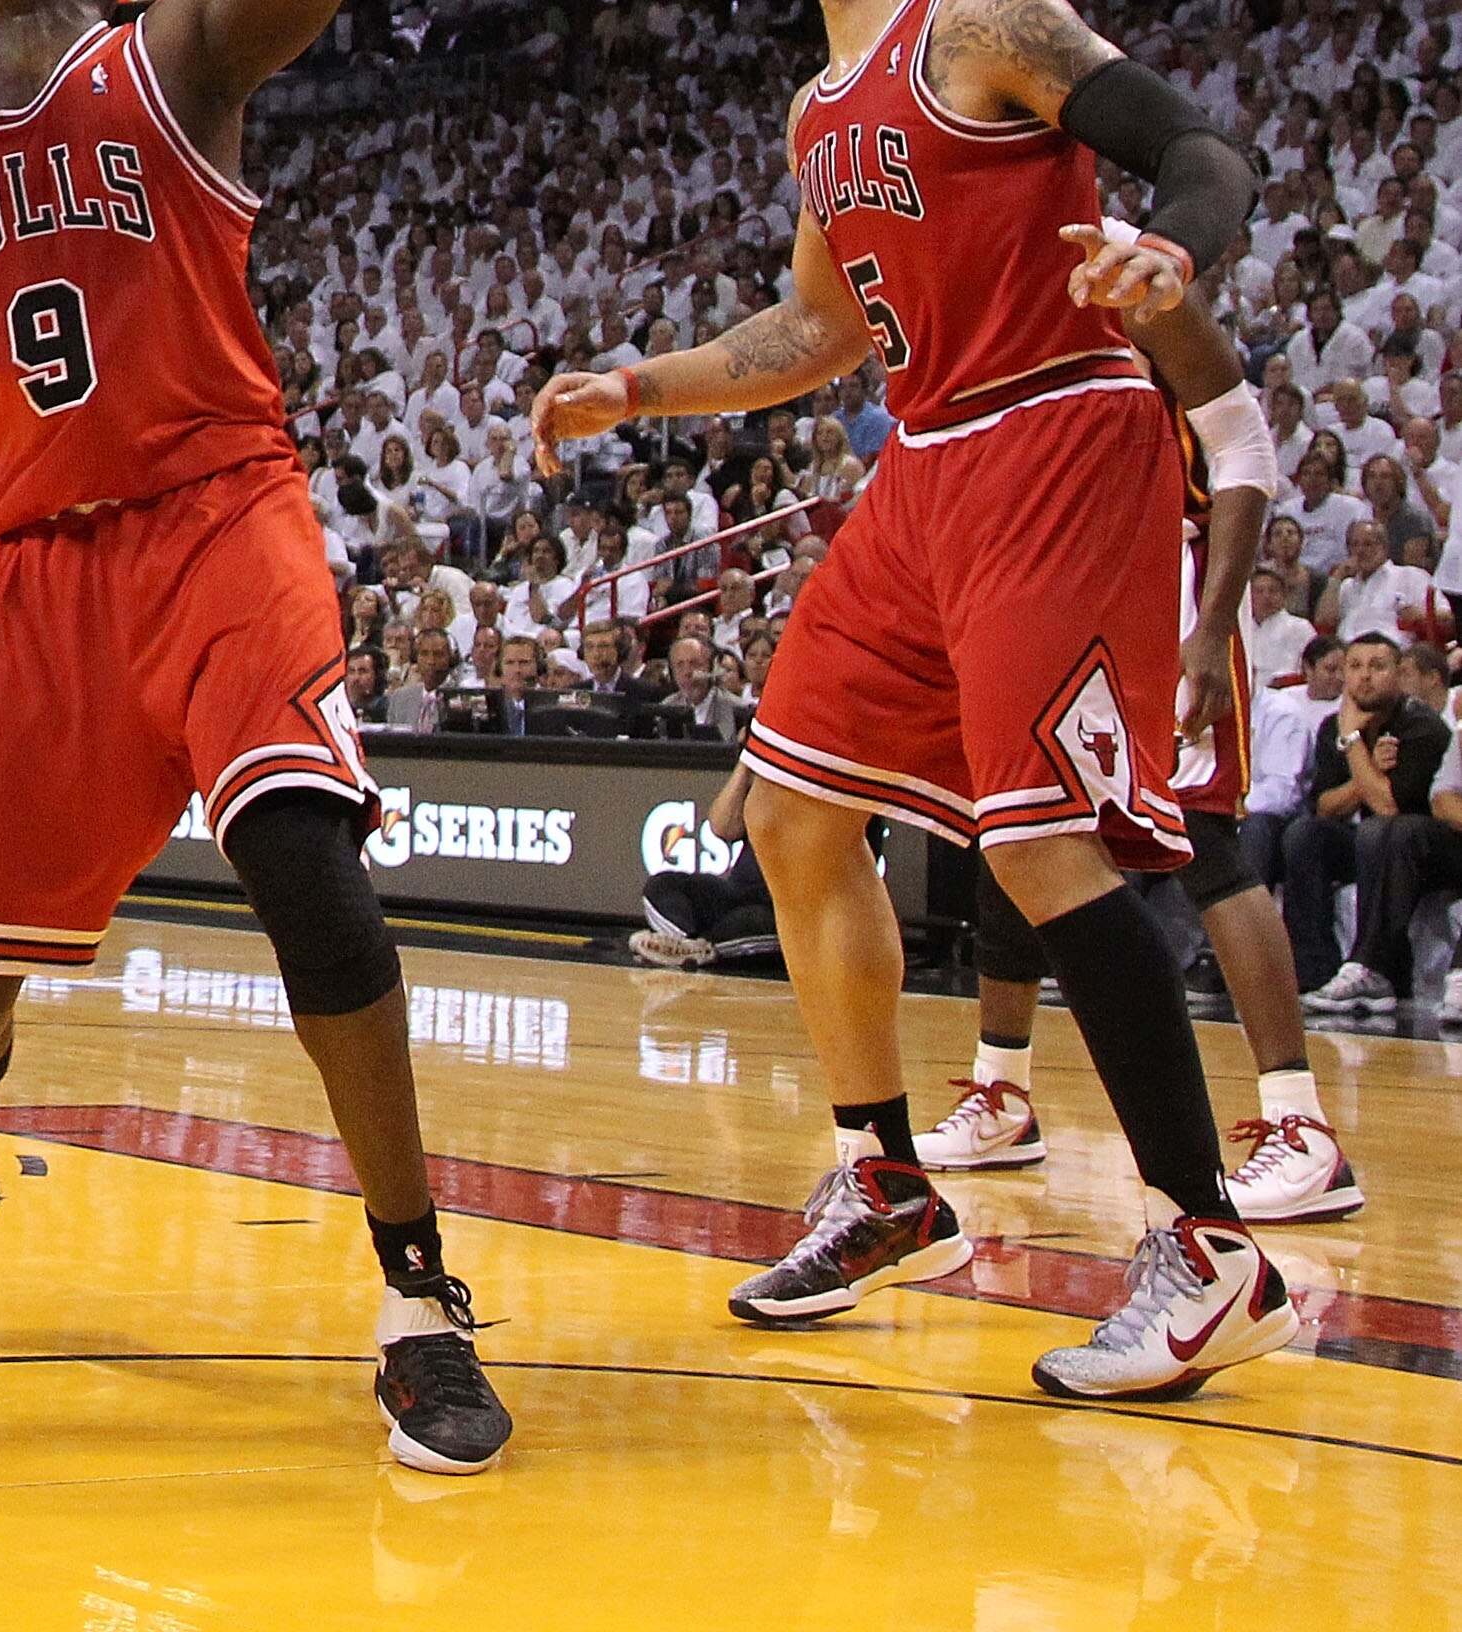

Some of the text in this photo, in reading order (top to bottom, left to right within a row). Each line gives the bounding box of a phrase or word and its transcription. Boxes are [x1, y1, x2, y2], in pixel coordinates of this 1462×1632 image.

[798, 123, 926, 232] ULLS
[6, 277, 98, 418] 9
[842, 252, 912, 373] 5
